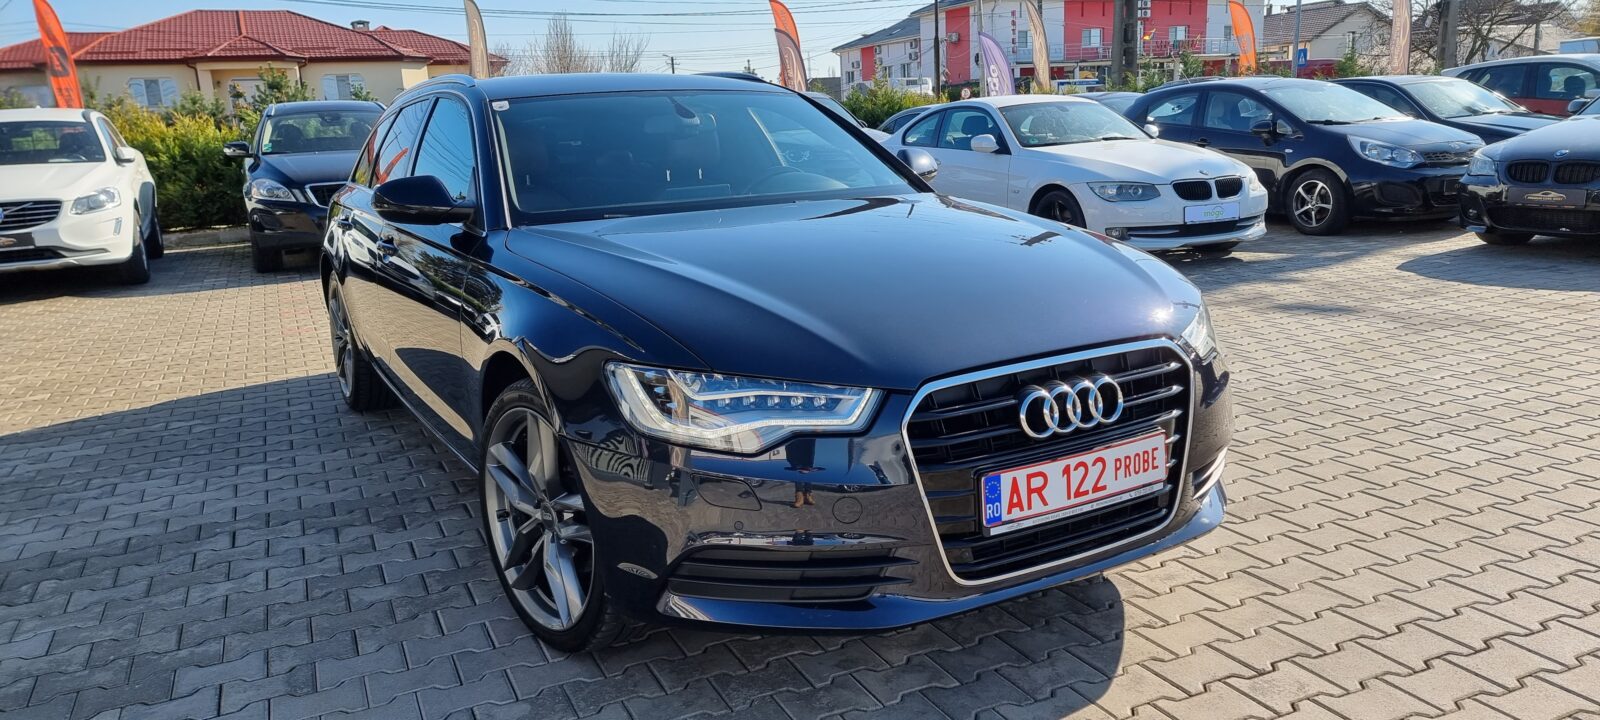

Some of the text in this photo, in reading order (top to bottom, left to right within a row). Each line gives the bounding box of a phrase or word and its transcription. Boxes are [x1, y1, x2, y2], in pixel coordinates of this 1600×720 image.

[1203, 210, 1224, 218] mogo
[1006, 447, 1159, 515] AR 122 PROBE
[986, 502, 1001, 519] RO
